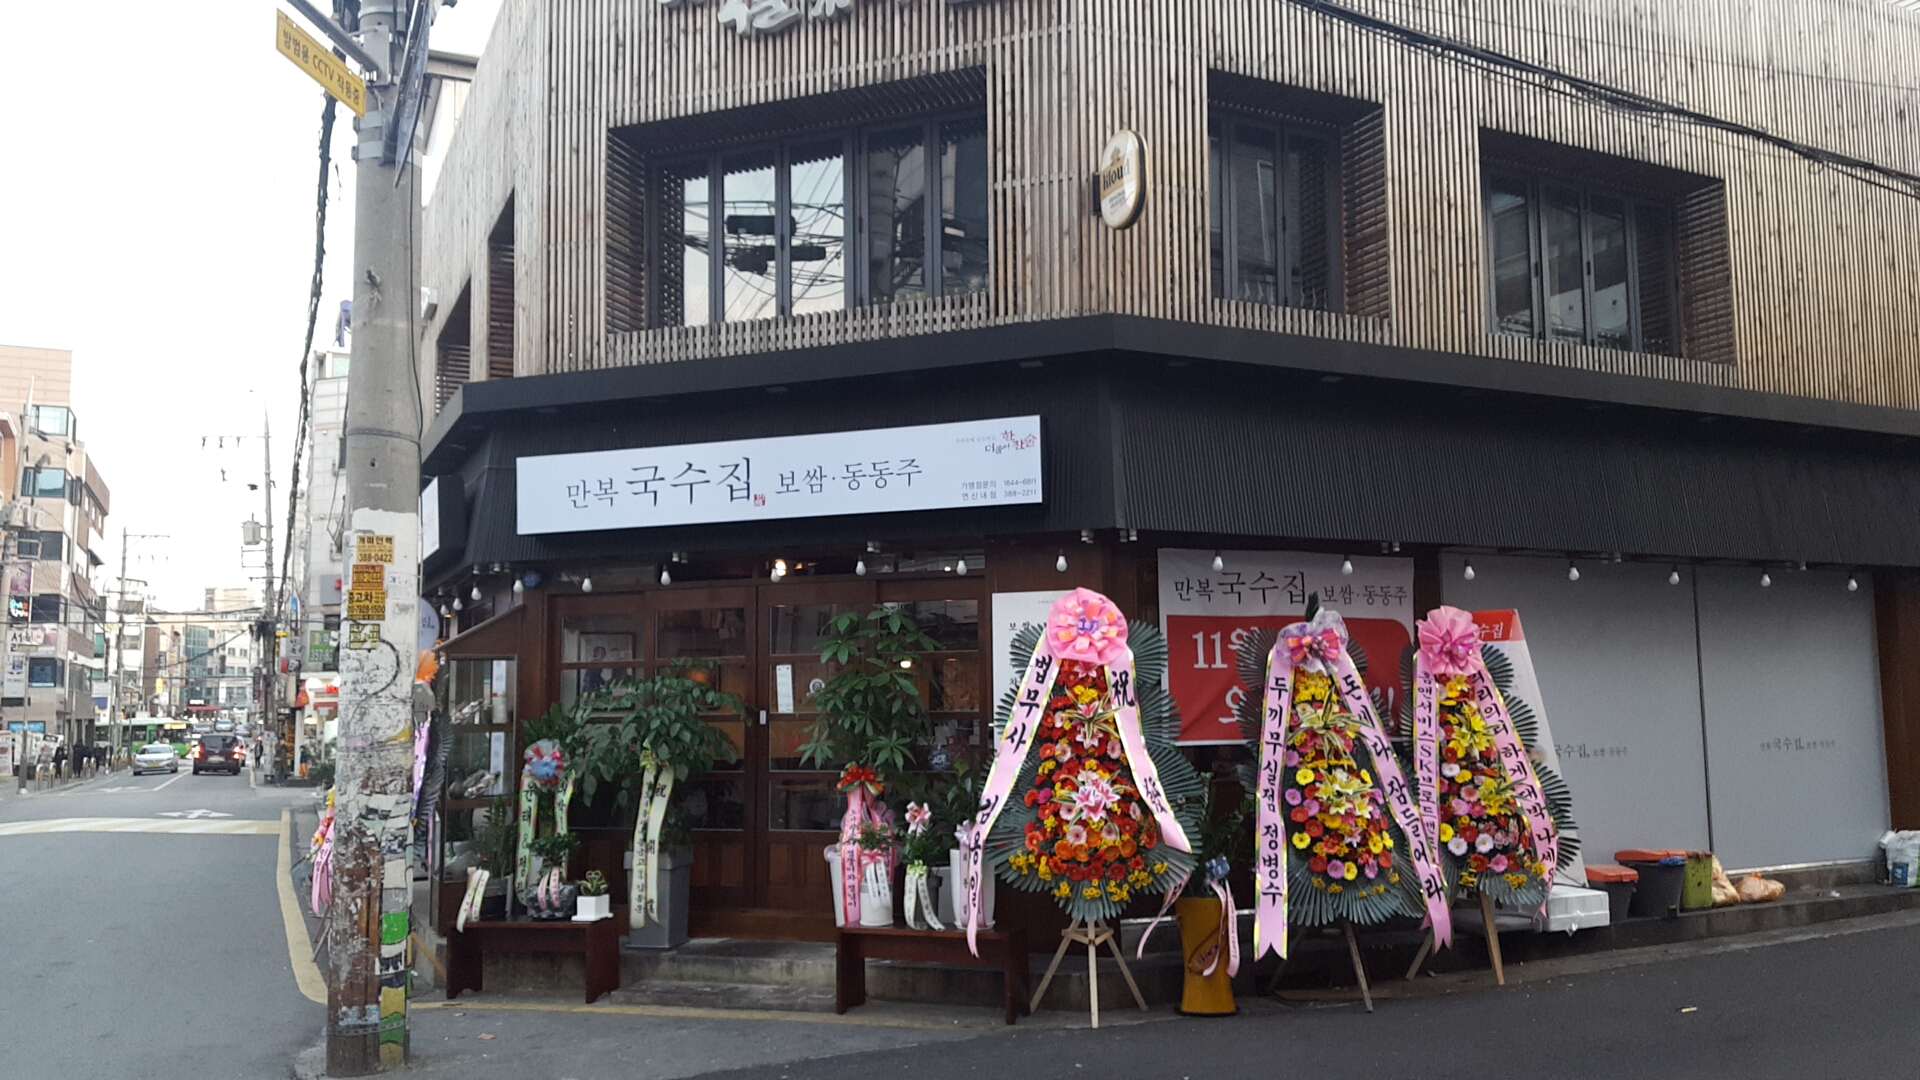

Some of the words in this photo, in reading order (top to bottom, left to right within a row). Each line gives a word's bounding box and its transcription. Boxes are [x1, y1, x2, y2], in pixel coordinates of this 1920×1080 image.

[283, 29, 309, 64] 방범용
[312, 54, 335, 82] CCTV
[337, 73, 360, 105] 작동중
[566, 478, 619, 509] 만복
[625, 456, 751, 507] 국수집
[1003, 478, 1037, 487] 1644-6811
[1003, 489, 1037, 498] 388-2211
[358, 551, 393, 563] 388-0422
[348, 591, 373, 604] 중고차
[1174, 577, 1214, 602] 만복
[1217, 570, 1306, 605] 국수집
[1478, 620, 1504, 639] 수집
[1005, 653, 1053, 755] 법무사
[1111, 670, 1135, 707] 祝
[931, 754, 947, 764] ADT
[1342, 674, 1390, 763] 돈세다
[1387, 776, 1443, 903] 잠들어라
[1261, 823, 1283, 907] 정병수
